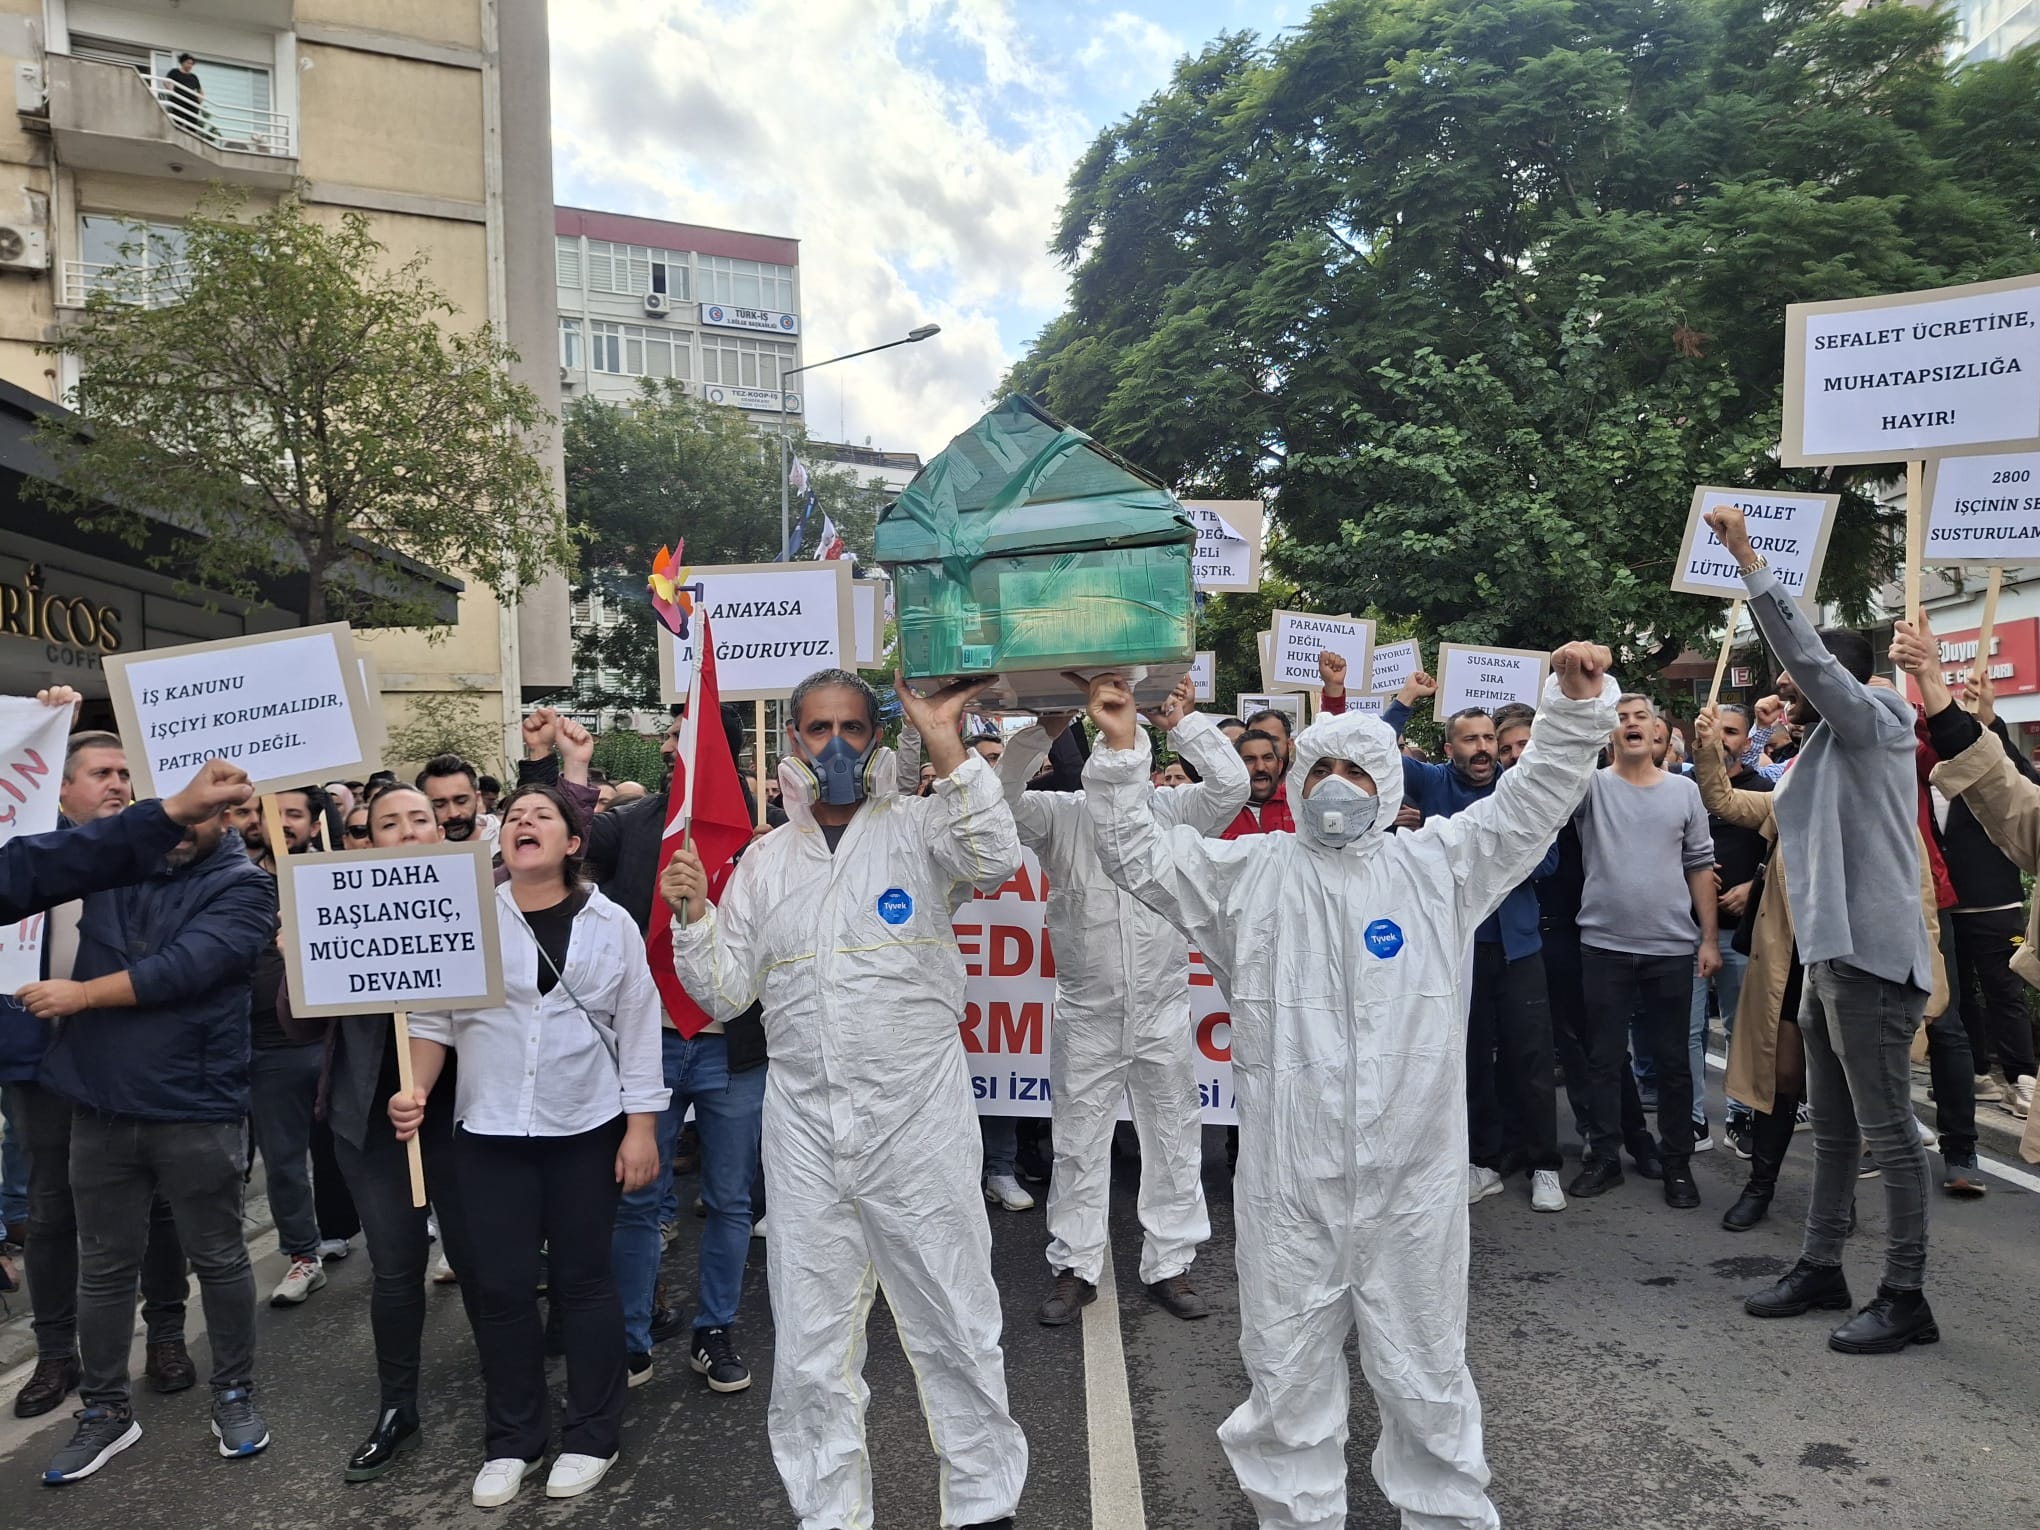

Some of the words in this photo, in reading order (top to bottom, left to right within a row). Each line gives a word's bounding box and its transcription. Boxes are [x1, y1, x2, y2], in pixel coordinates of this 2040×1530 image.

[1814, 327, 1905, 351] SEFALET
[1913, 311, 2036, 340] ÜCRETİNE,
[1823, 356, 2022, 392] MUHATAPSIZLIĞA
[1881, 410, 1955, 431] HAYIR!
[1992, 470, 2030, 484] 2800
[1200, 511, 1220, 521] TE
[1954, 496, 2019, 516] İŞÇİNİN
[710, 600, 802, 619] ANAYASA
[1290, 619, 1356, 635] PARAVANLA
[682, 640, 834, 661] MĞDURUYUZ.
[1288, 635, 1326, 649] DEĞİL,
[1940, 637, 2000, 663] Duymr
[1467, 655, 1520, 669] SUSARSAK
[1286, 666, 1322, 681] KONU
[1480, 673, 1504, 684] SIRA
[141, 688, 160, 706] İŞ
[165, 676, 245, 701] KANUNU
[1465, 688, 1516, 701] HEPİMİZE
[150, 713, 207, 740] İŞÇİYİ
[212, 694, 344, 727] KORUMALIDIR,
[158, 743, 243, 772] PATRONU
[248, 732, 307, 755] DEĞİL.
[332, 870, 363, 890] BU
[371, 864, 440, 888] DAHA
[317, 898, 461, 929] BAŞLANGIÇ,
[884, 902, 907, 912] Tyvek
[309, 932, 475, 961] MÜCADELEYE
[1371, 932, 1398, 945] Tyvek
[349, 968, 442, 993] DEVAM!
